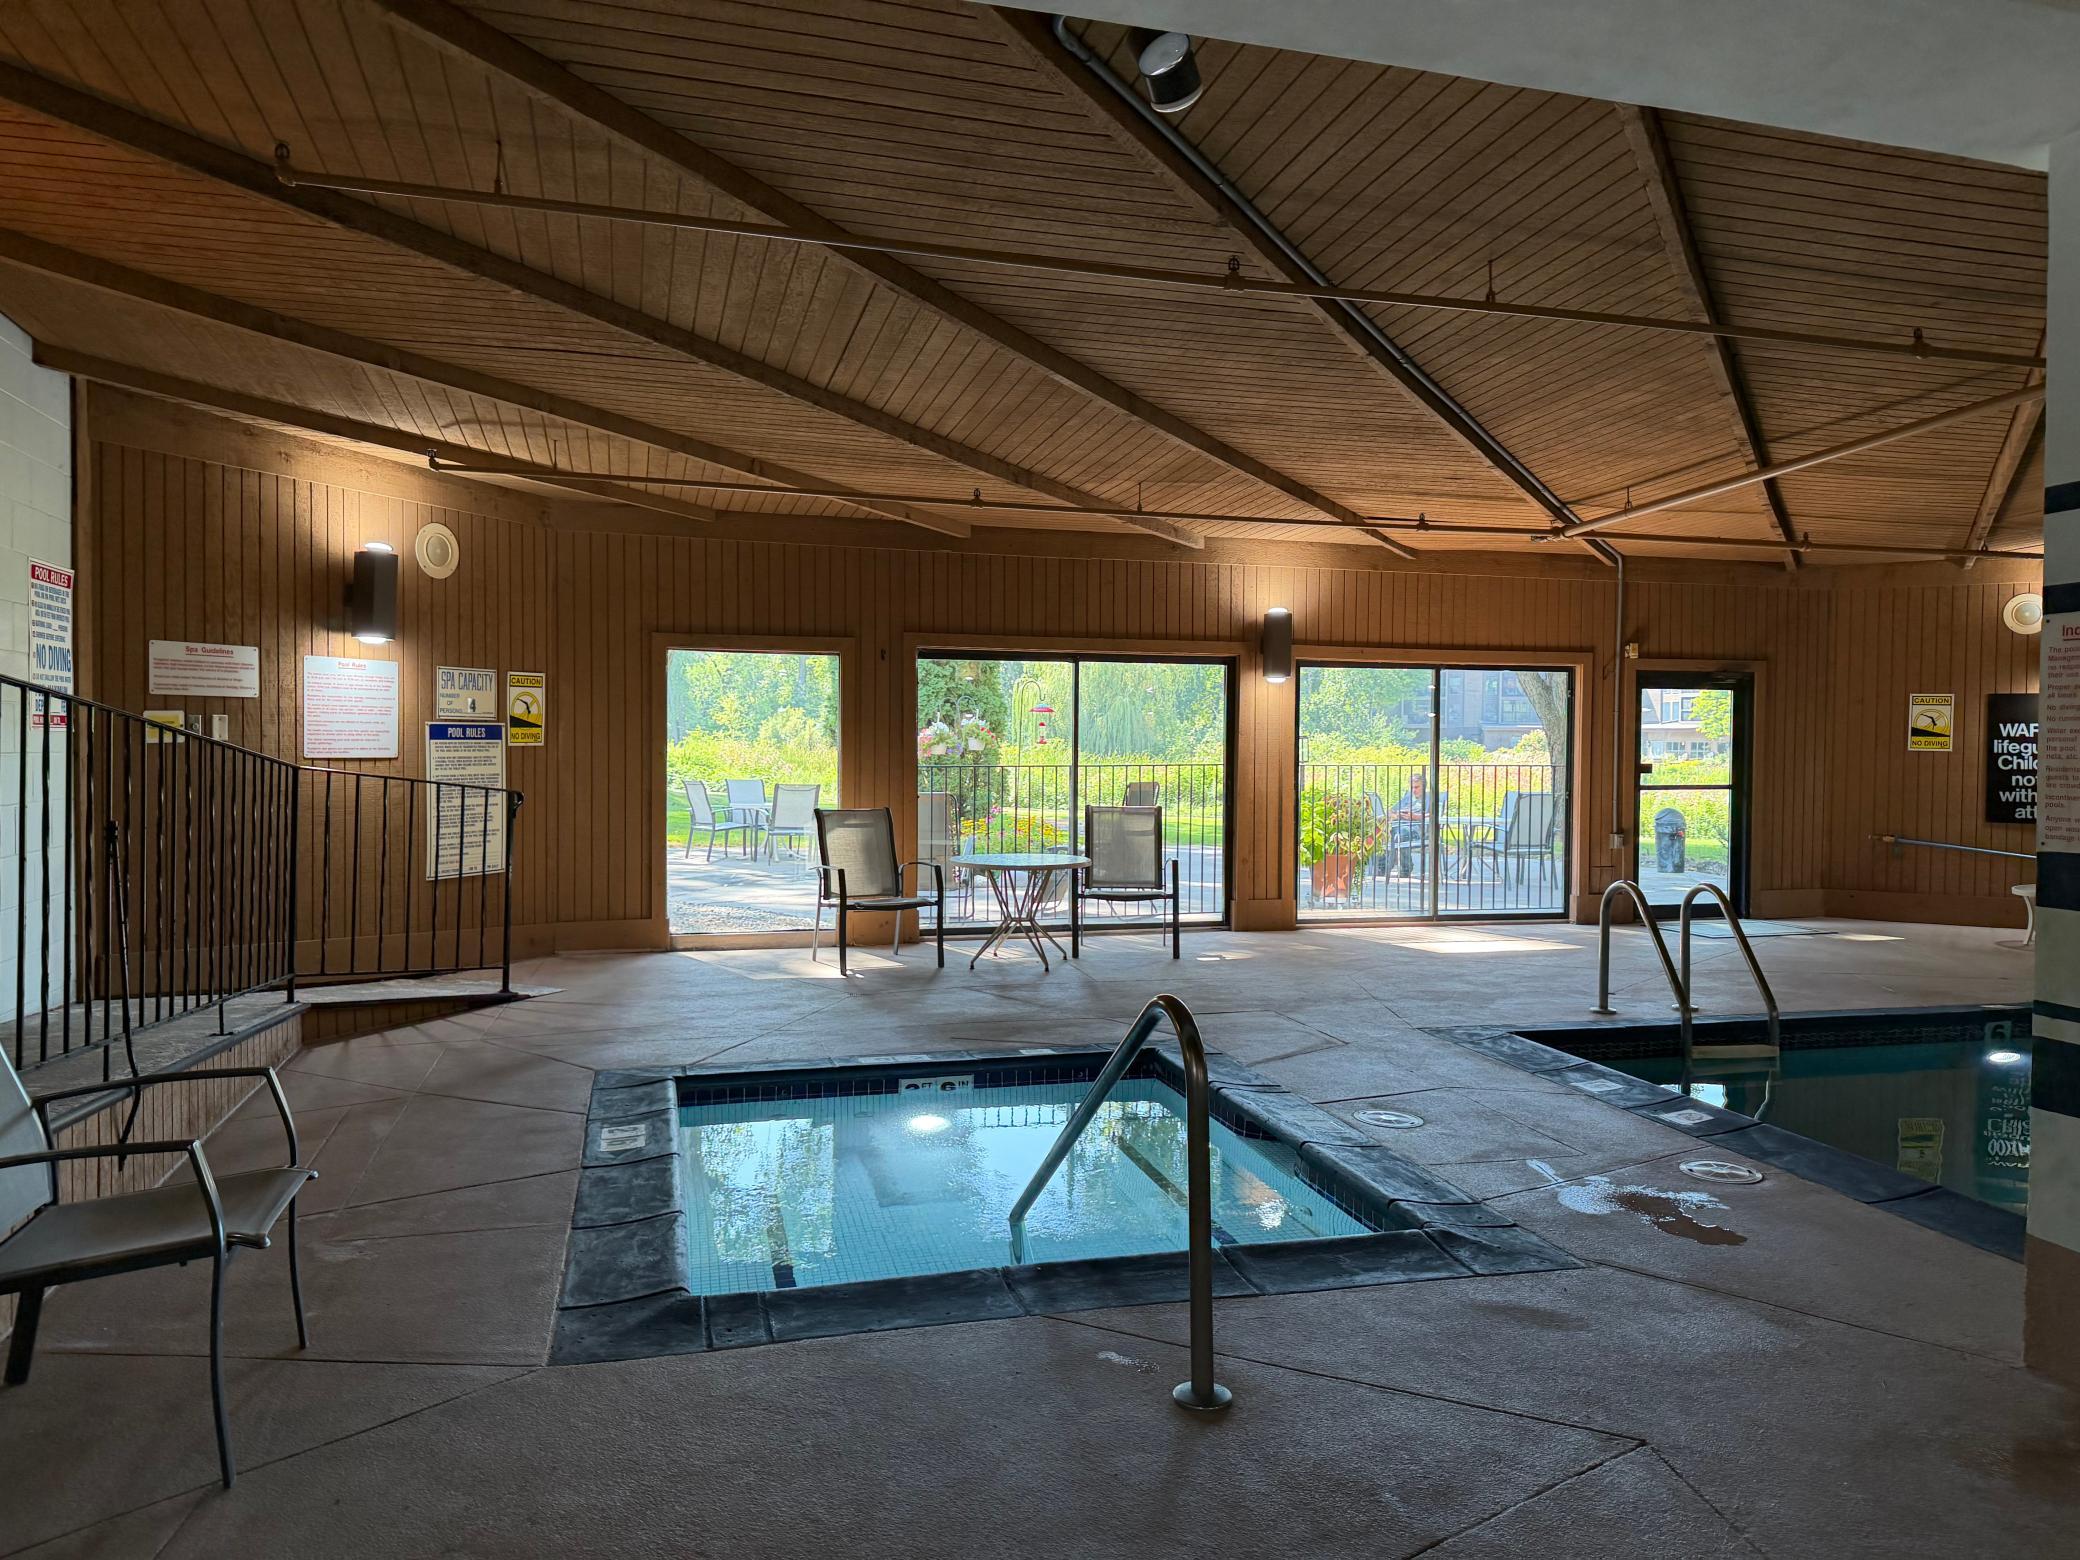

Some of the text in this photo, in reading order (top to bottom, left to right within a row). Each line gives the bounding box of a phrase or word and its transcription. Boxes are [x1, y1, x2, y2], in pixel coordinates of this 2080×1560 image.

[34, 566, 69, 587] POOL RULES
[185, 646, 234, 655] Spa Guidelines
[36, 643, 72, 673] NO DIVING
[441, 671, 493, 692] SPA CAPACITY
[511, 677, 541, 685] CAUTION
[469, 698, 477, 713] 4
[447, 727, 486, 738] POOL RULES
[511, 732, 541, 740] NO DIVING
